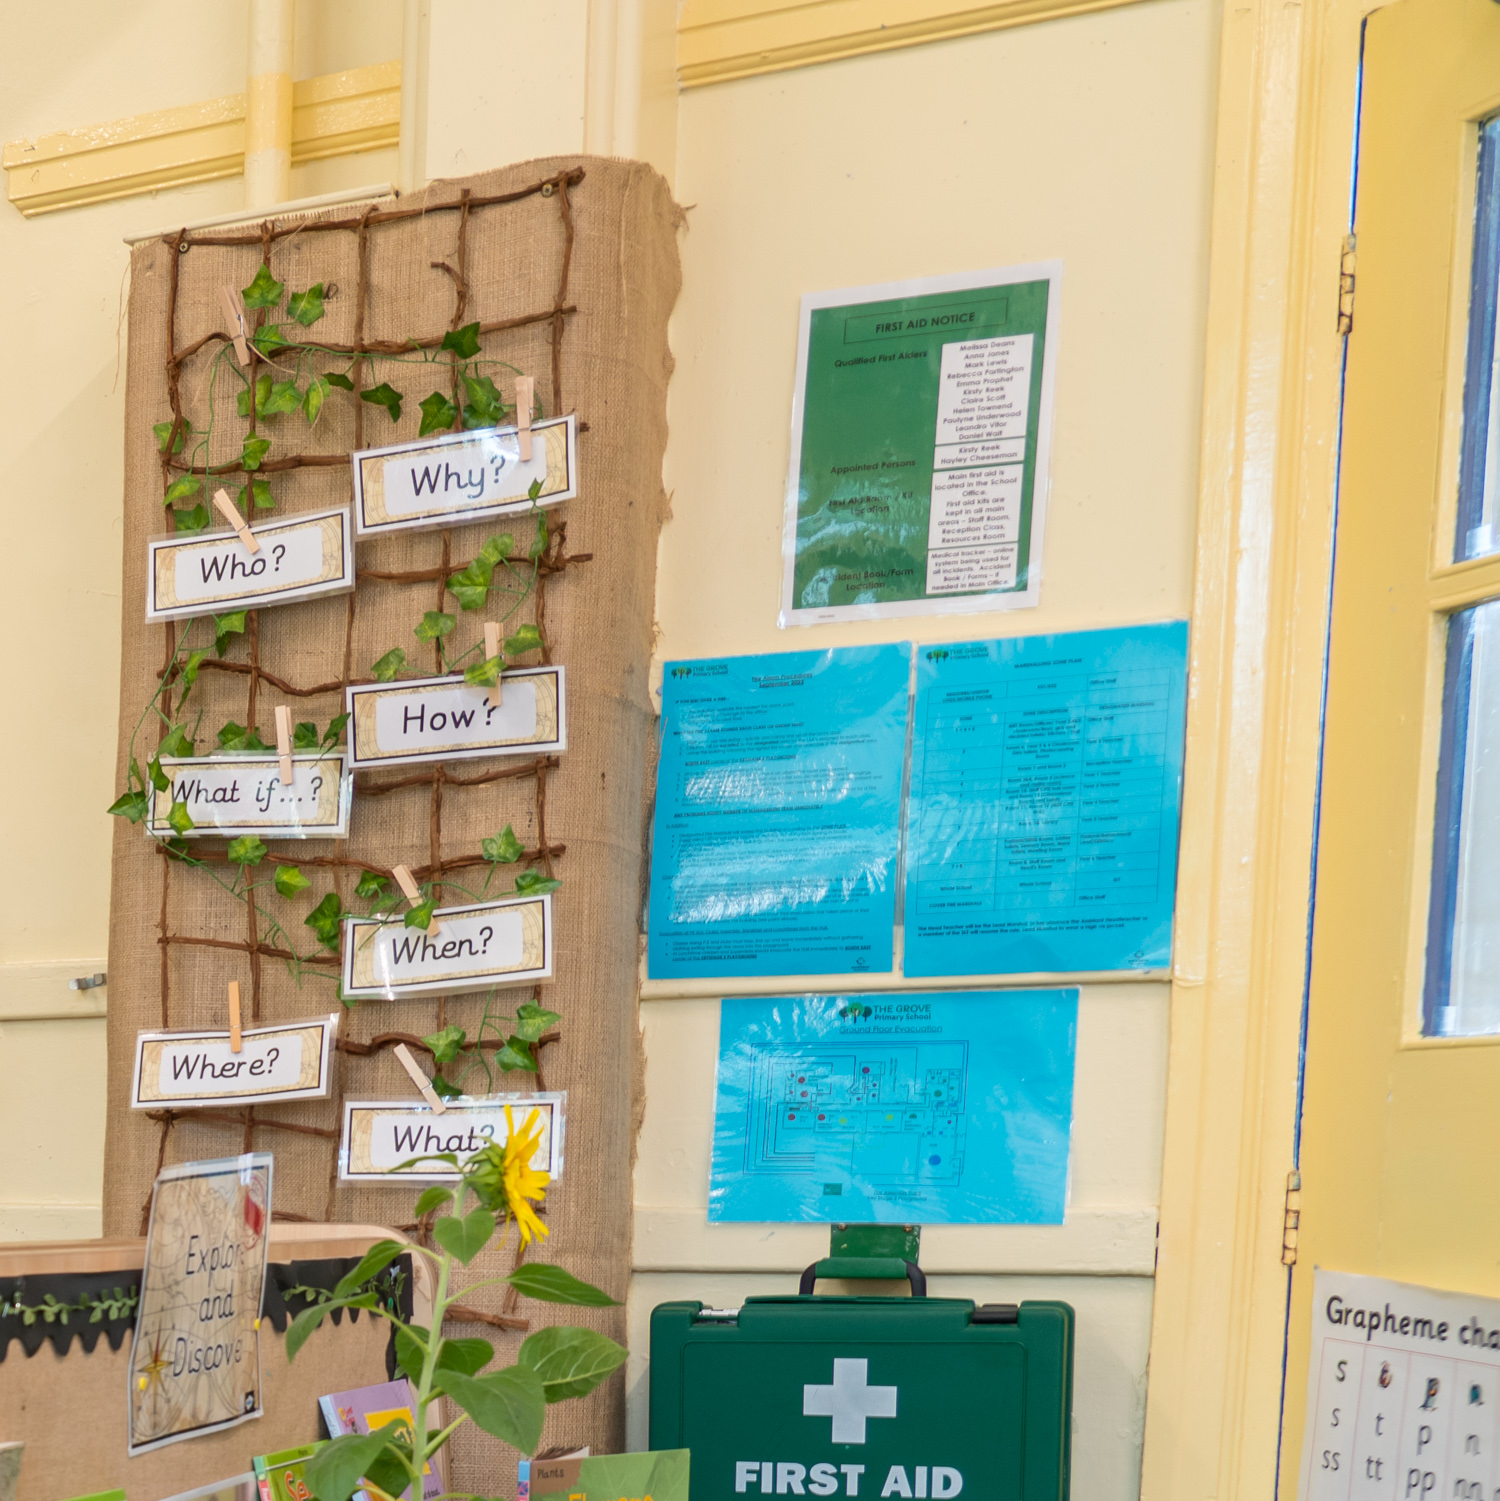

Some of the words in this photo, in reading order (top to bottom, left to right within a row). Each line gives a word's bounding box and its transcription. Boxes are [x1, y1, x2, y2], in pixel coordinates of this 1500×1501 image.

[875, 321, 904, 334] FIRST
[906, 318, 928, 330] AID
[931, 311, 976, 327] NOTICE
[410, 453, 507, 500] Why?
[199, 543, 287, 584] Who?
[402, 704, 499, 736] How?
[170, 778, 240, 805] What
[391, 926, 494, 965] When?
[873, 1005, 893, 1013] THE
[895, 1004, 932, 1013] GROVE
[874, 1013, 904, 1021] Primary
[171, 1047, 281, 1081] Where?
[392, 1123, 495, 1154] What?
[199, 1286, 235, 1323] and
[1325, 1295, 1450, 1341] Grapheme
[537, 1467, 565, 1480] Plants
[1321, 1450, 1340, 1471] ss
[1366, 1455, 1383, 1482] tt
[734, 1460, 866, 1497] FIRST
[880, 1465, 964, 1500] AID
[1404, 1467, 1436, 1501] pp
